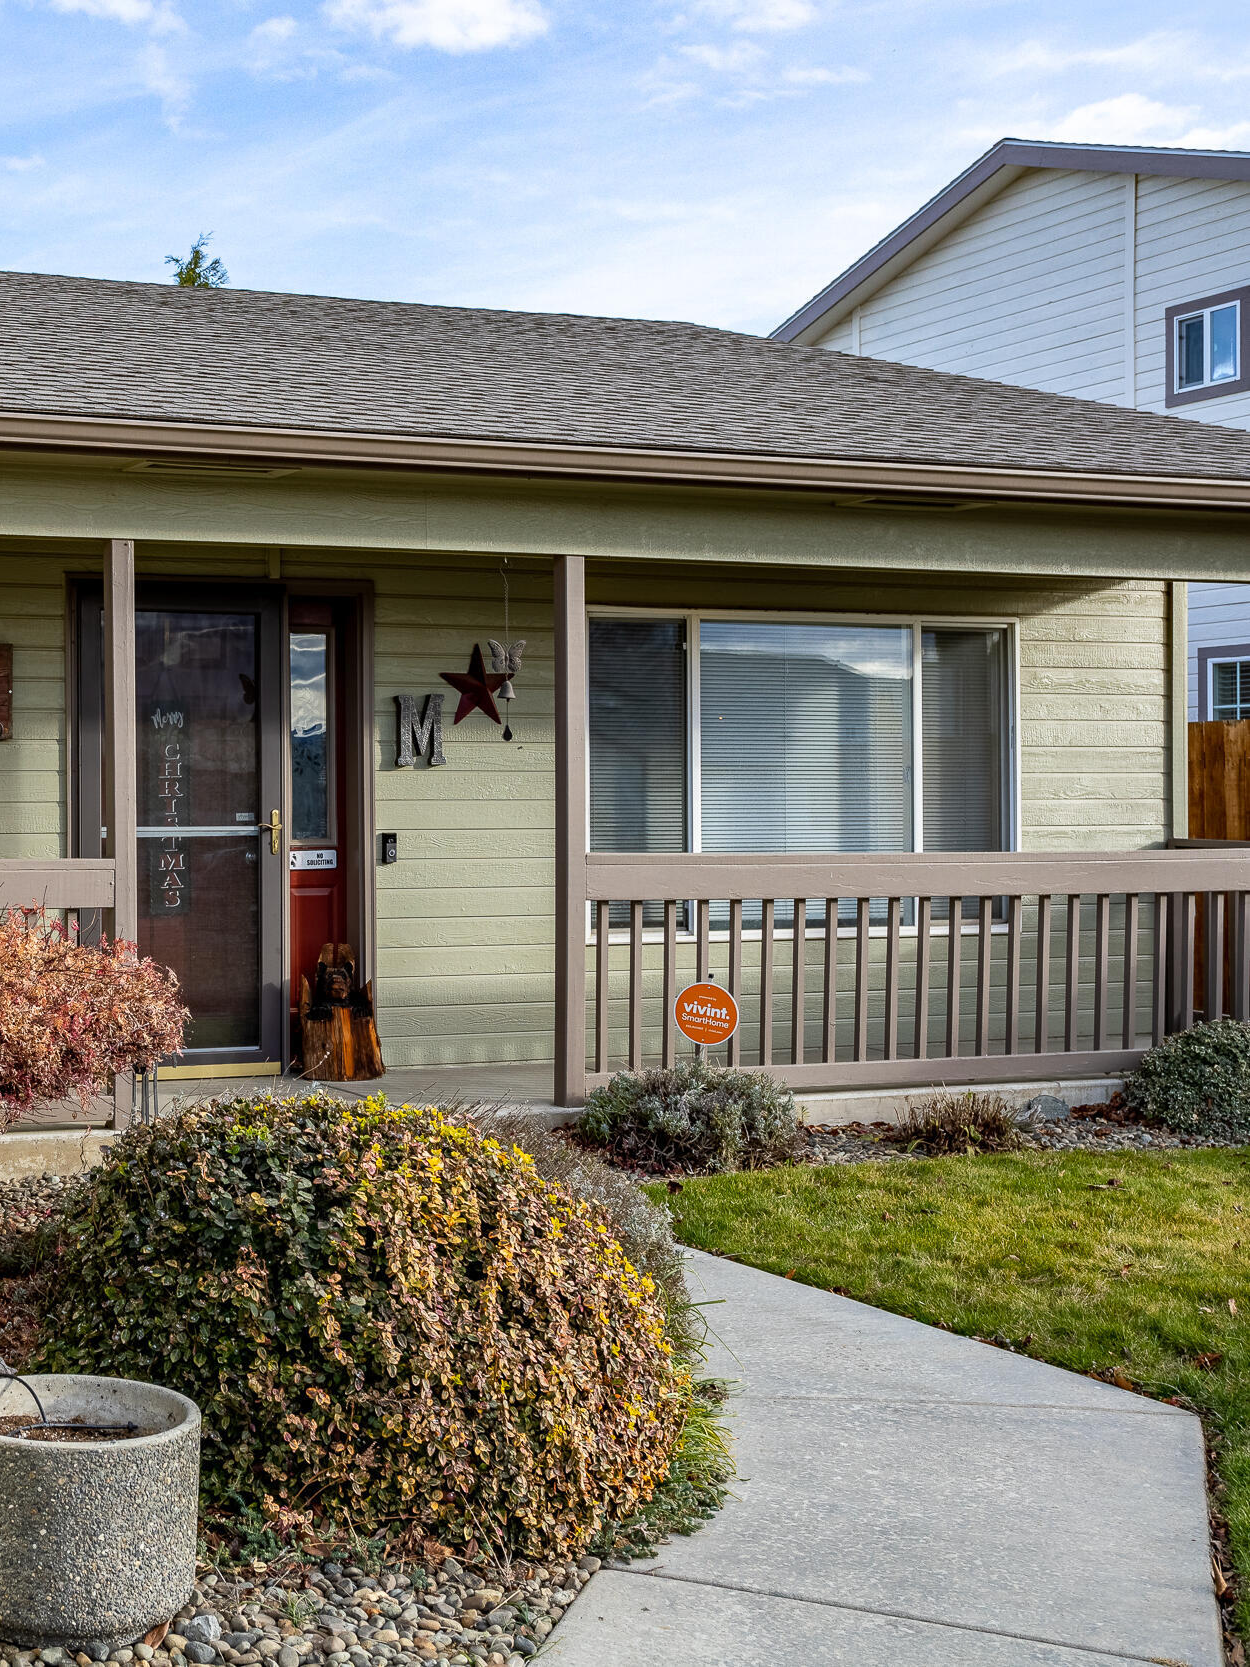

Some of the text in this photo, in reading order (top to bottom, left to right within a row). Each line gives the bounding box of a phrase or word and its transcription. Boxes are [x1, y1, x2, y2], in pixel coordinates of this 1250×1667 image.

[150, 707, 184, 729] Merry
[393, 693, 447, 767] M
[681, 1012, 729, 1029] SmartHome
